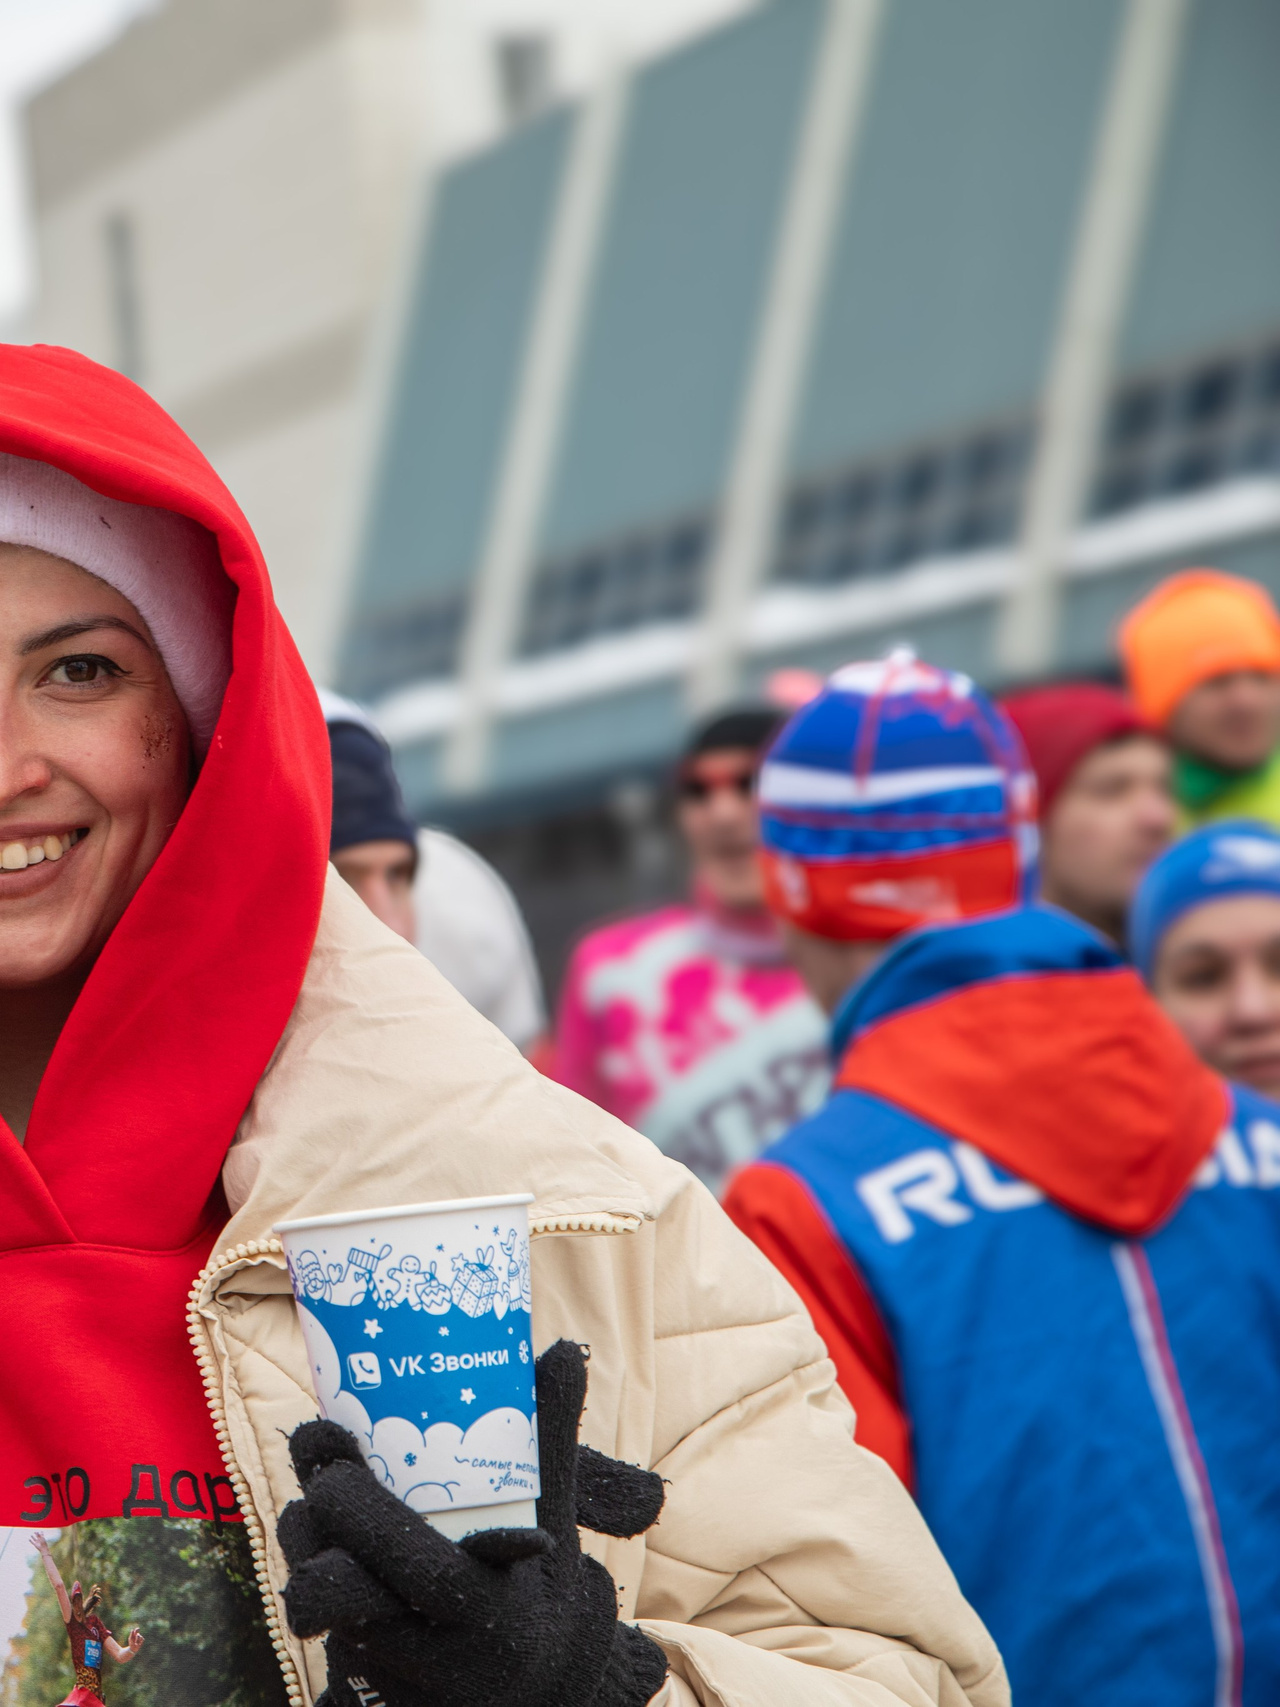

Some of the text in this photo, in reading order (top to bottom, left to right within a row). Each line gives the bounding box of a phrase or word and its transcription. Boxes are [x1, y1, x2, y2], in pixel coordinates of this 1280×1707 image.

[388, 1349, 509, 1377] VK Звонки
[471, 1457, 513, 1470] самые
[493, 1471, 529, 1493] звонки
